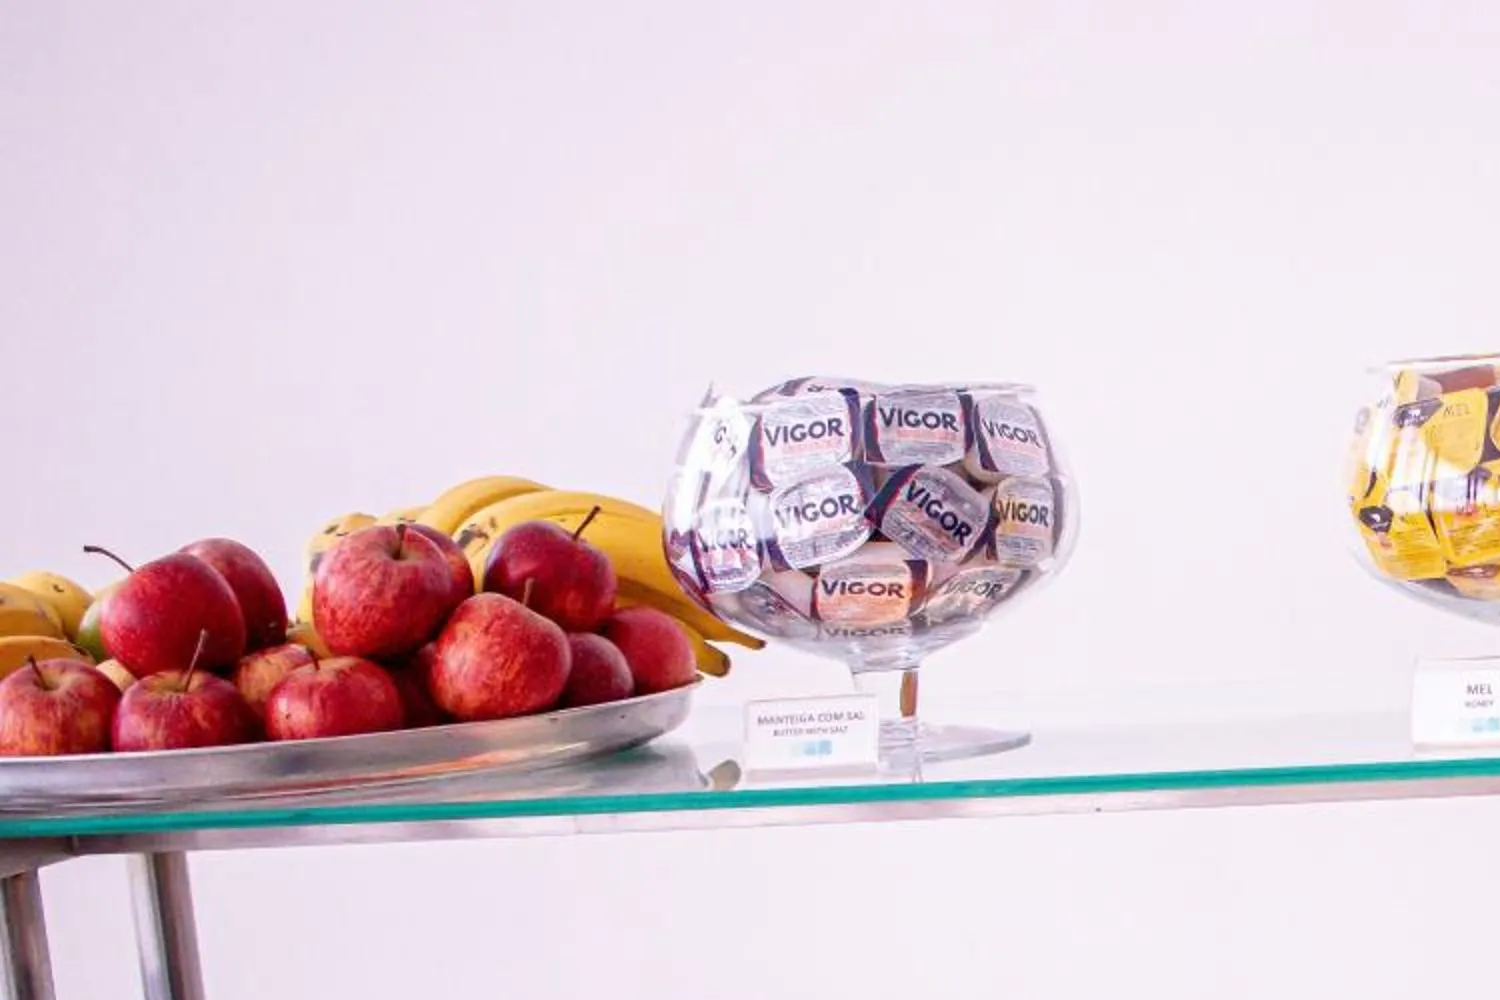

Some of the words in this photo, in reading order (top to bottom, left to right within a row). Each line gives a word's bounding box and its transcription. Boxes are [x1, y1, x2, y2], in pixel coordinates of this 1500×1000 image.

[764, 418, 845, 447] VIGOR
[879, 408, 960, 433] VIGOR
[982, 419, 1042, 448] VIGOR
[775, 494, 861, 528] VIGOR
[906, 480, 973, 546] VIGOR
[998, 502, 1050, 528] VIGOR
[821, 579, 905, 599] VIGOR
[1465, 683, 1494, 696] MEL
[757, 713, 815, 726] MANTEIGA
[817, 711, 845, 723] COM
[846, 711, 866, 721] SAL
